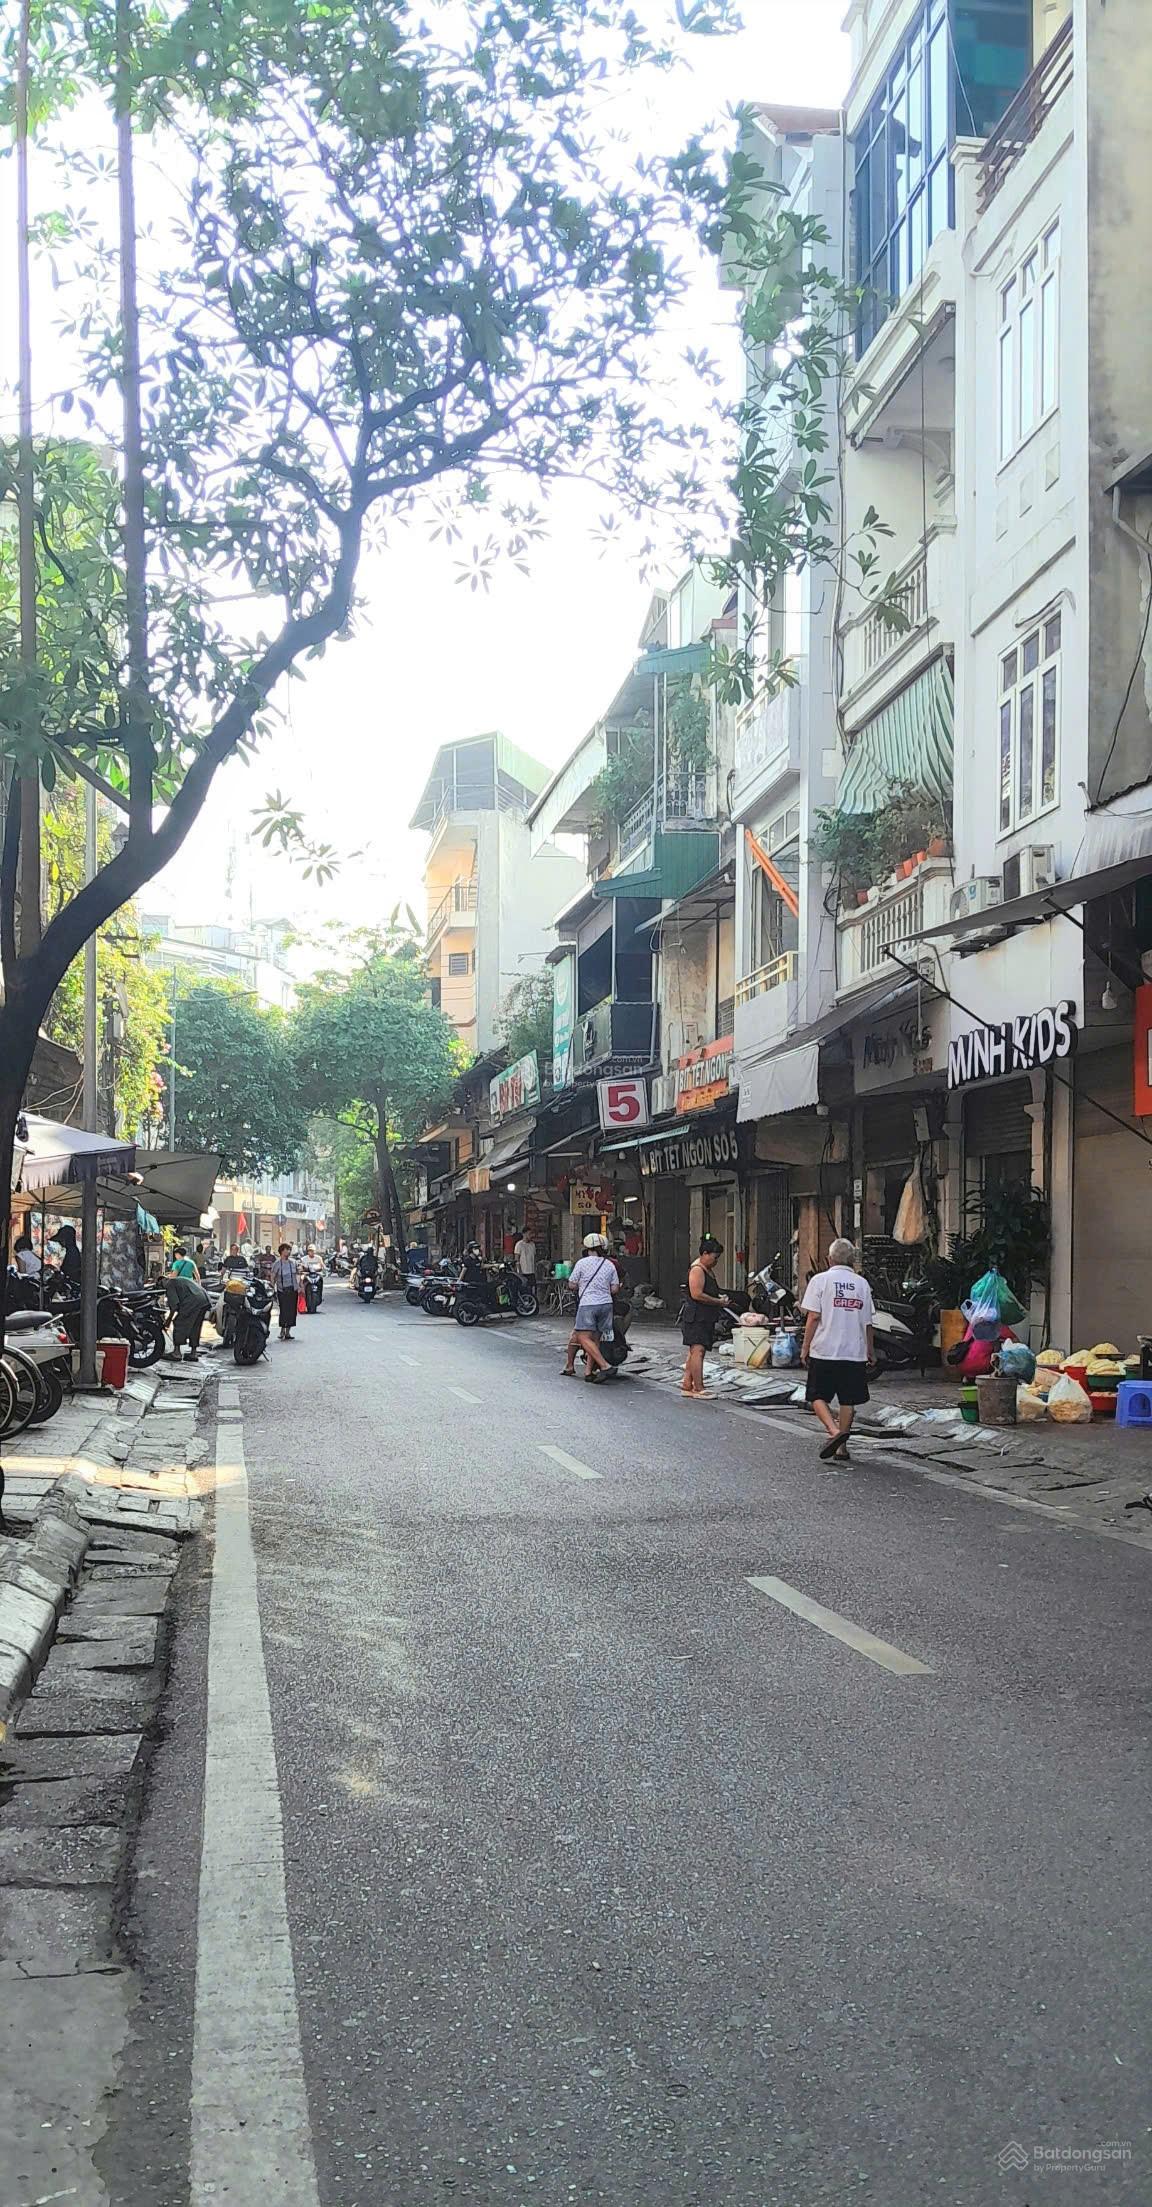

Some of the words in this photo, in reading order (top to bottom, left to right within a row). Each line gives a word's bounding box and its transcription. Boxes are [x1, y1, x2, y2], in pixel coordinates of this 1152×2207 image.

[947, 1021, 1010, 1090] MINH
[1013, 1000, 1074, 1069] KIDS
[607, 1084, 641, 1122] 5
[682, 1137, 712, 1168] NGON
[833, 1282, 855, 1291] THIS
[835, 1290, 845, 1298] IS
[834, 1298, 863, 1309] GREAT
